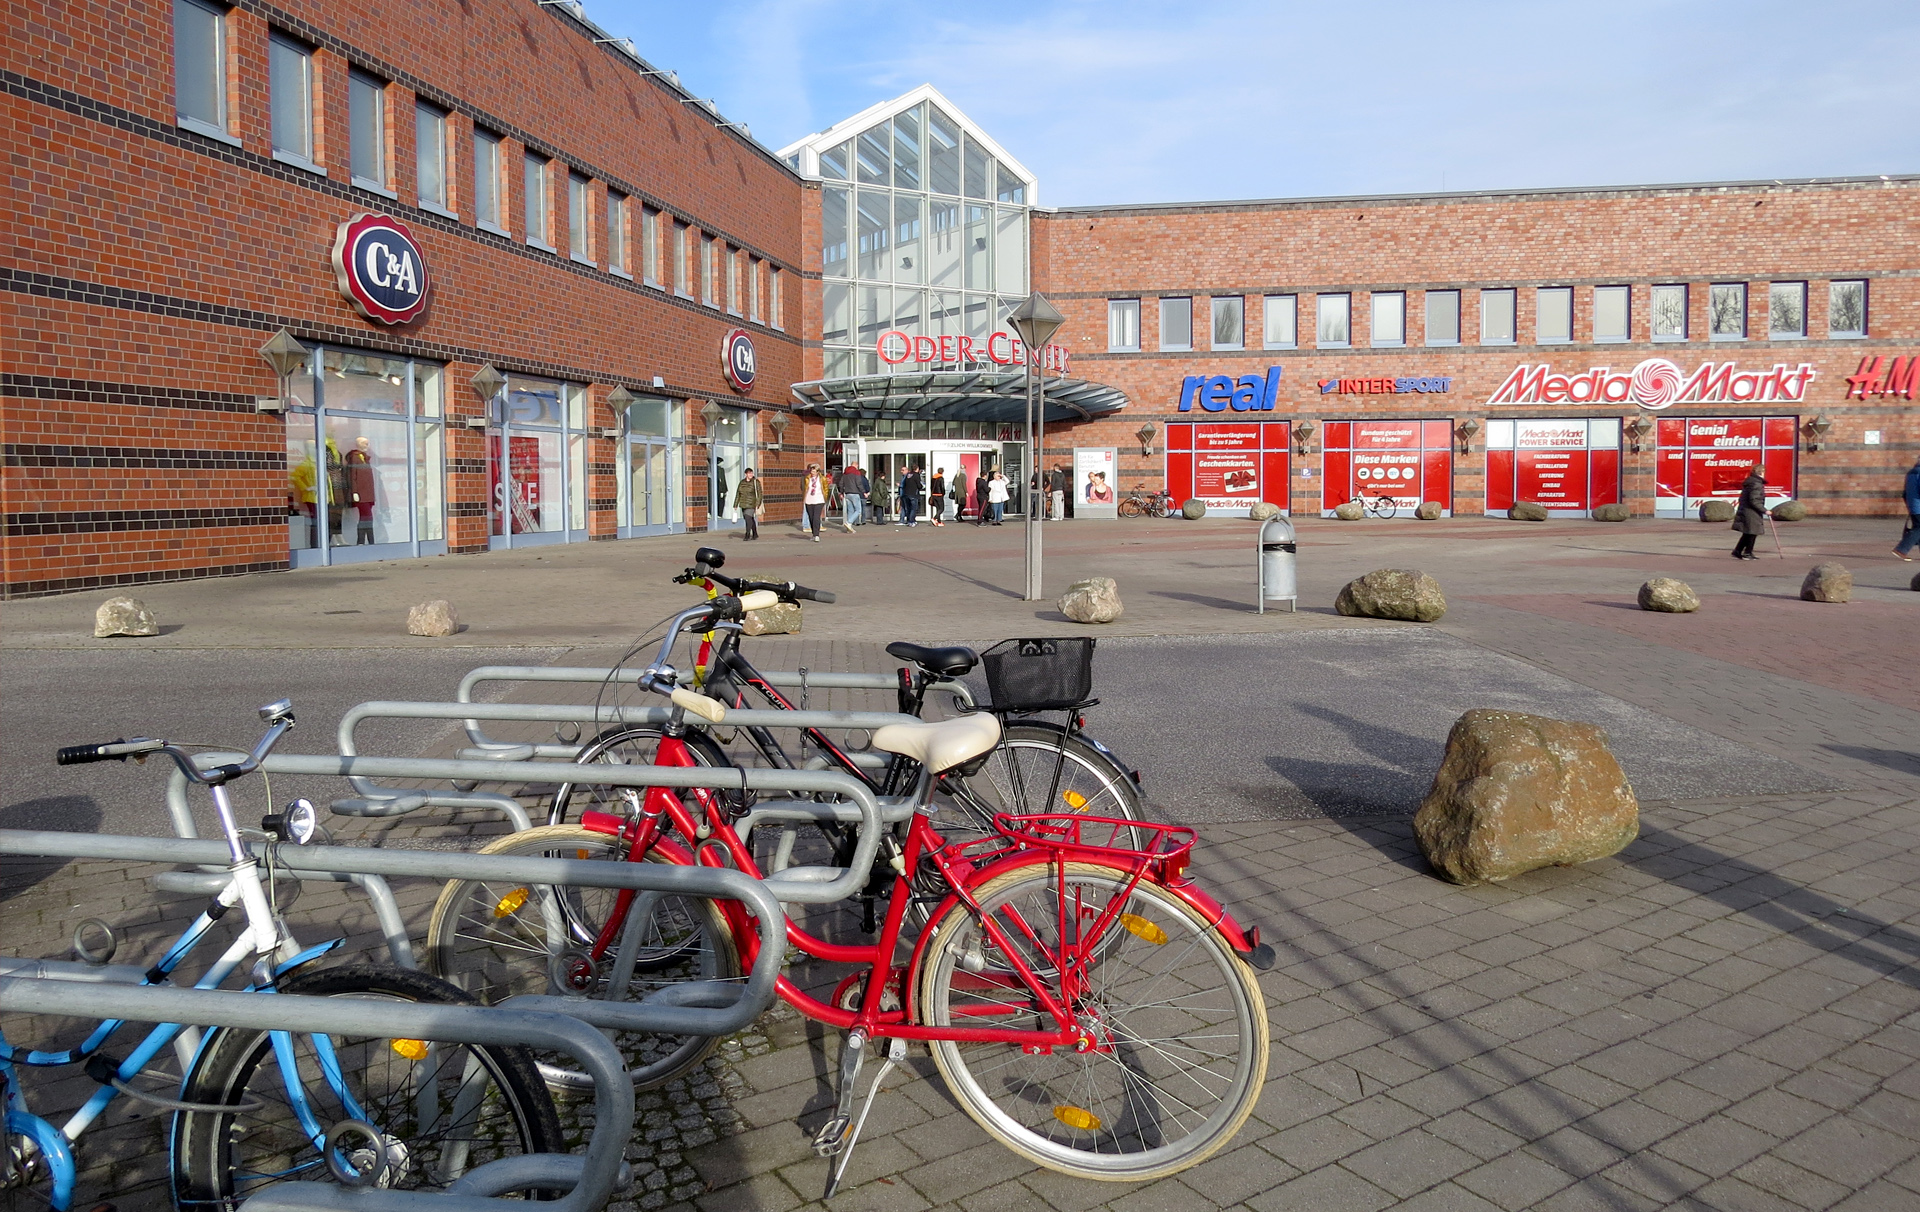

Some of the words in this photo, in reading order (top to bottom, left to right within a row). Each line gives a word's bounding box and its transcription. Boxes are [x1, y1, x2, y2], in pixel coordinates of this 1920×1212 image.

[366, 242, 419, 295] C&A
[736, 345, 755, 374] C&A
[1178, 365, 1282, 411] real
[1339, 376, 1453, 394] INTERSPORT
[1690, 424, 1728, 436] Genial
[1713, 436, 1759, 447] einfach
[1355, 454, 1380, 464] Diese
[1380, 454, 1418, 464] Marken
[1668, 452, 1684, 460] und
[1690, 452, 1716, 460] immer
[1199, 460, 1255, 468] Geschenkkarten.
[1718, 459, 1753, 468] Richtige!
